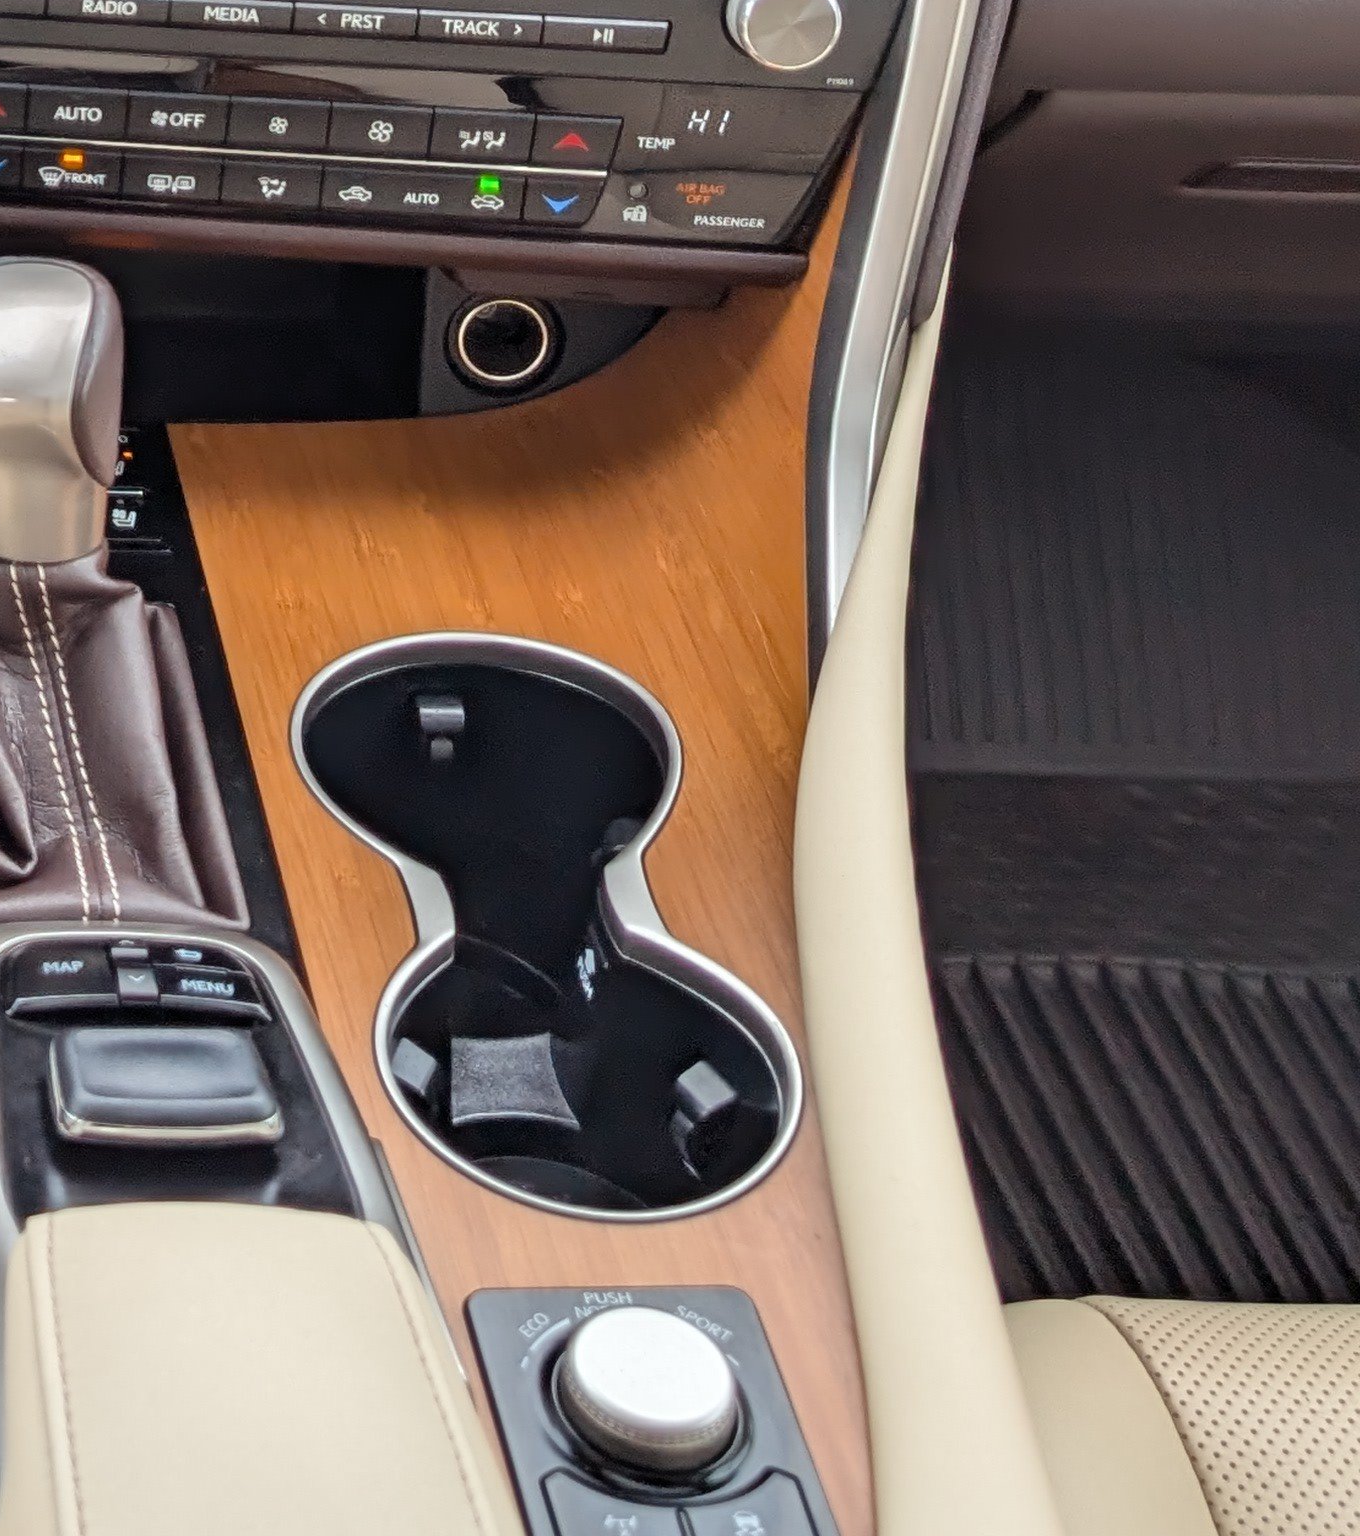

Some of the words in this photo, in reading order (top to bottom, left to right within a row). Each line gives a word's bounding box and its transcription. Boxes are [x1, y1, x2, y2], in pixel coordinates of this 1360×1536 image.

[82, 0, 137, 16] RADIO
[203, 4, 260, 24] MEDIA
[340, 12, 385, 31] PRST
[441, 18, 500, 37] TRACK
[53, 106, 103, 123] AUTO
[169, 113, 205, 129] OFF
[636, 136, 676, 150] TEMP
[64, 172, 107, 187] FRONT
[403, 192, 440, 206] AUTO
[686, 194, 712, 205] OFF
[693, 215, 767, 229] PASSENGER
[41, 960, 84, 975] MAP
[180, 979, 235, 997] MENU
[583, 1290, 634, 1305] PUSH
[518, 1312, 551, 1339] ECO
[676, 1304, 733, 1342] SPORT
